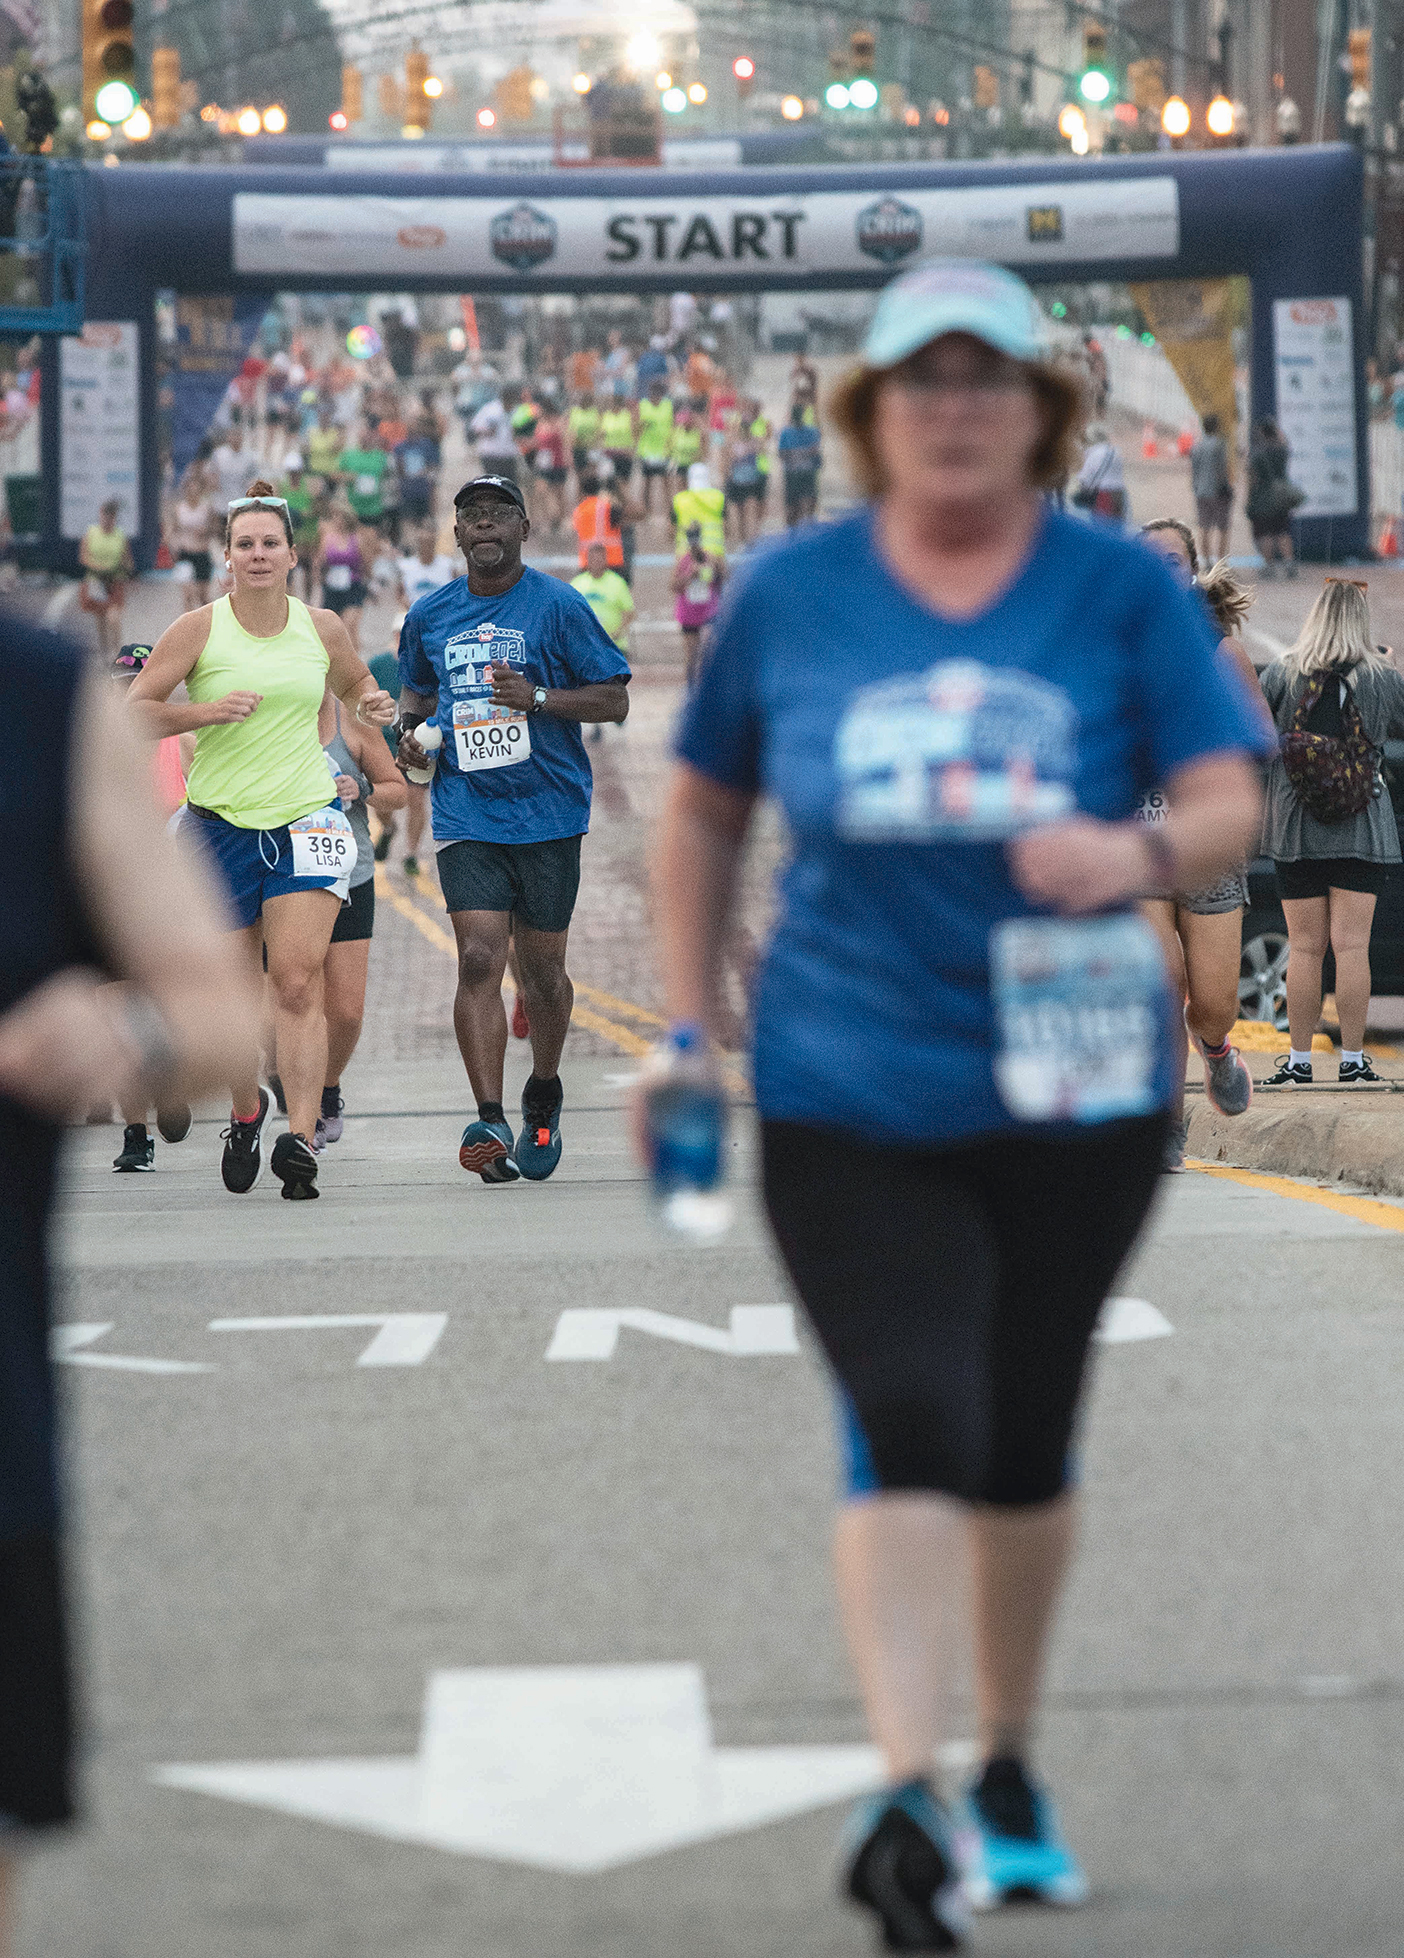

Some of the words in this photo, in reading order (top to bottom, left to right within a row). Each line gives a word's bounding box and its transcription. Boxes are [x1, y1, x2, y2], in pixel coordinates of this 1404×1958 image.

[605, 209, 806, 262] START
[444, 643, 491, 671] CRIM
[490, 639, 527, 664] 2021
[461, 725, 521, 748] 1000
[469, 743, 512, 761] KEVIN
[1137, 809, 1170, 821] AMY
[307, 836, 346, 855] 396
[315, 854, 342, 868] LISA
